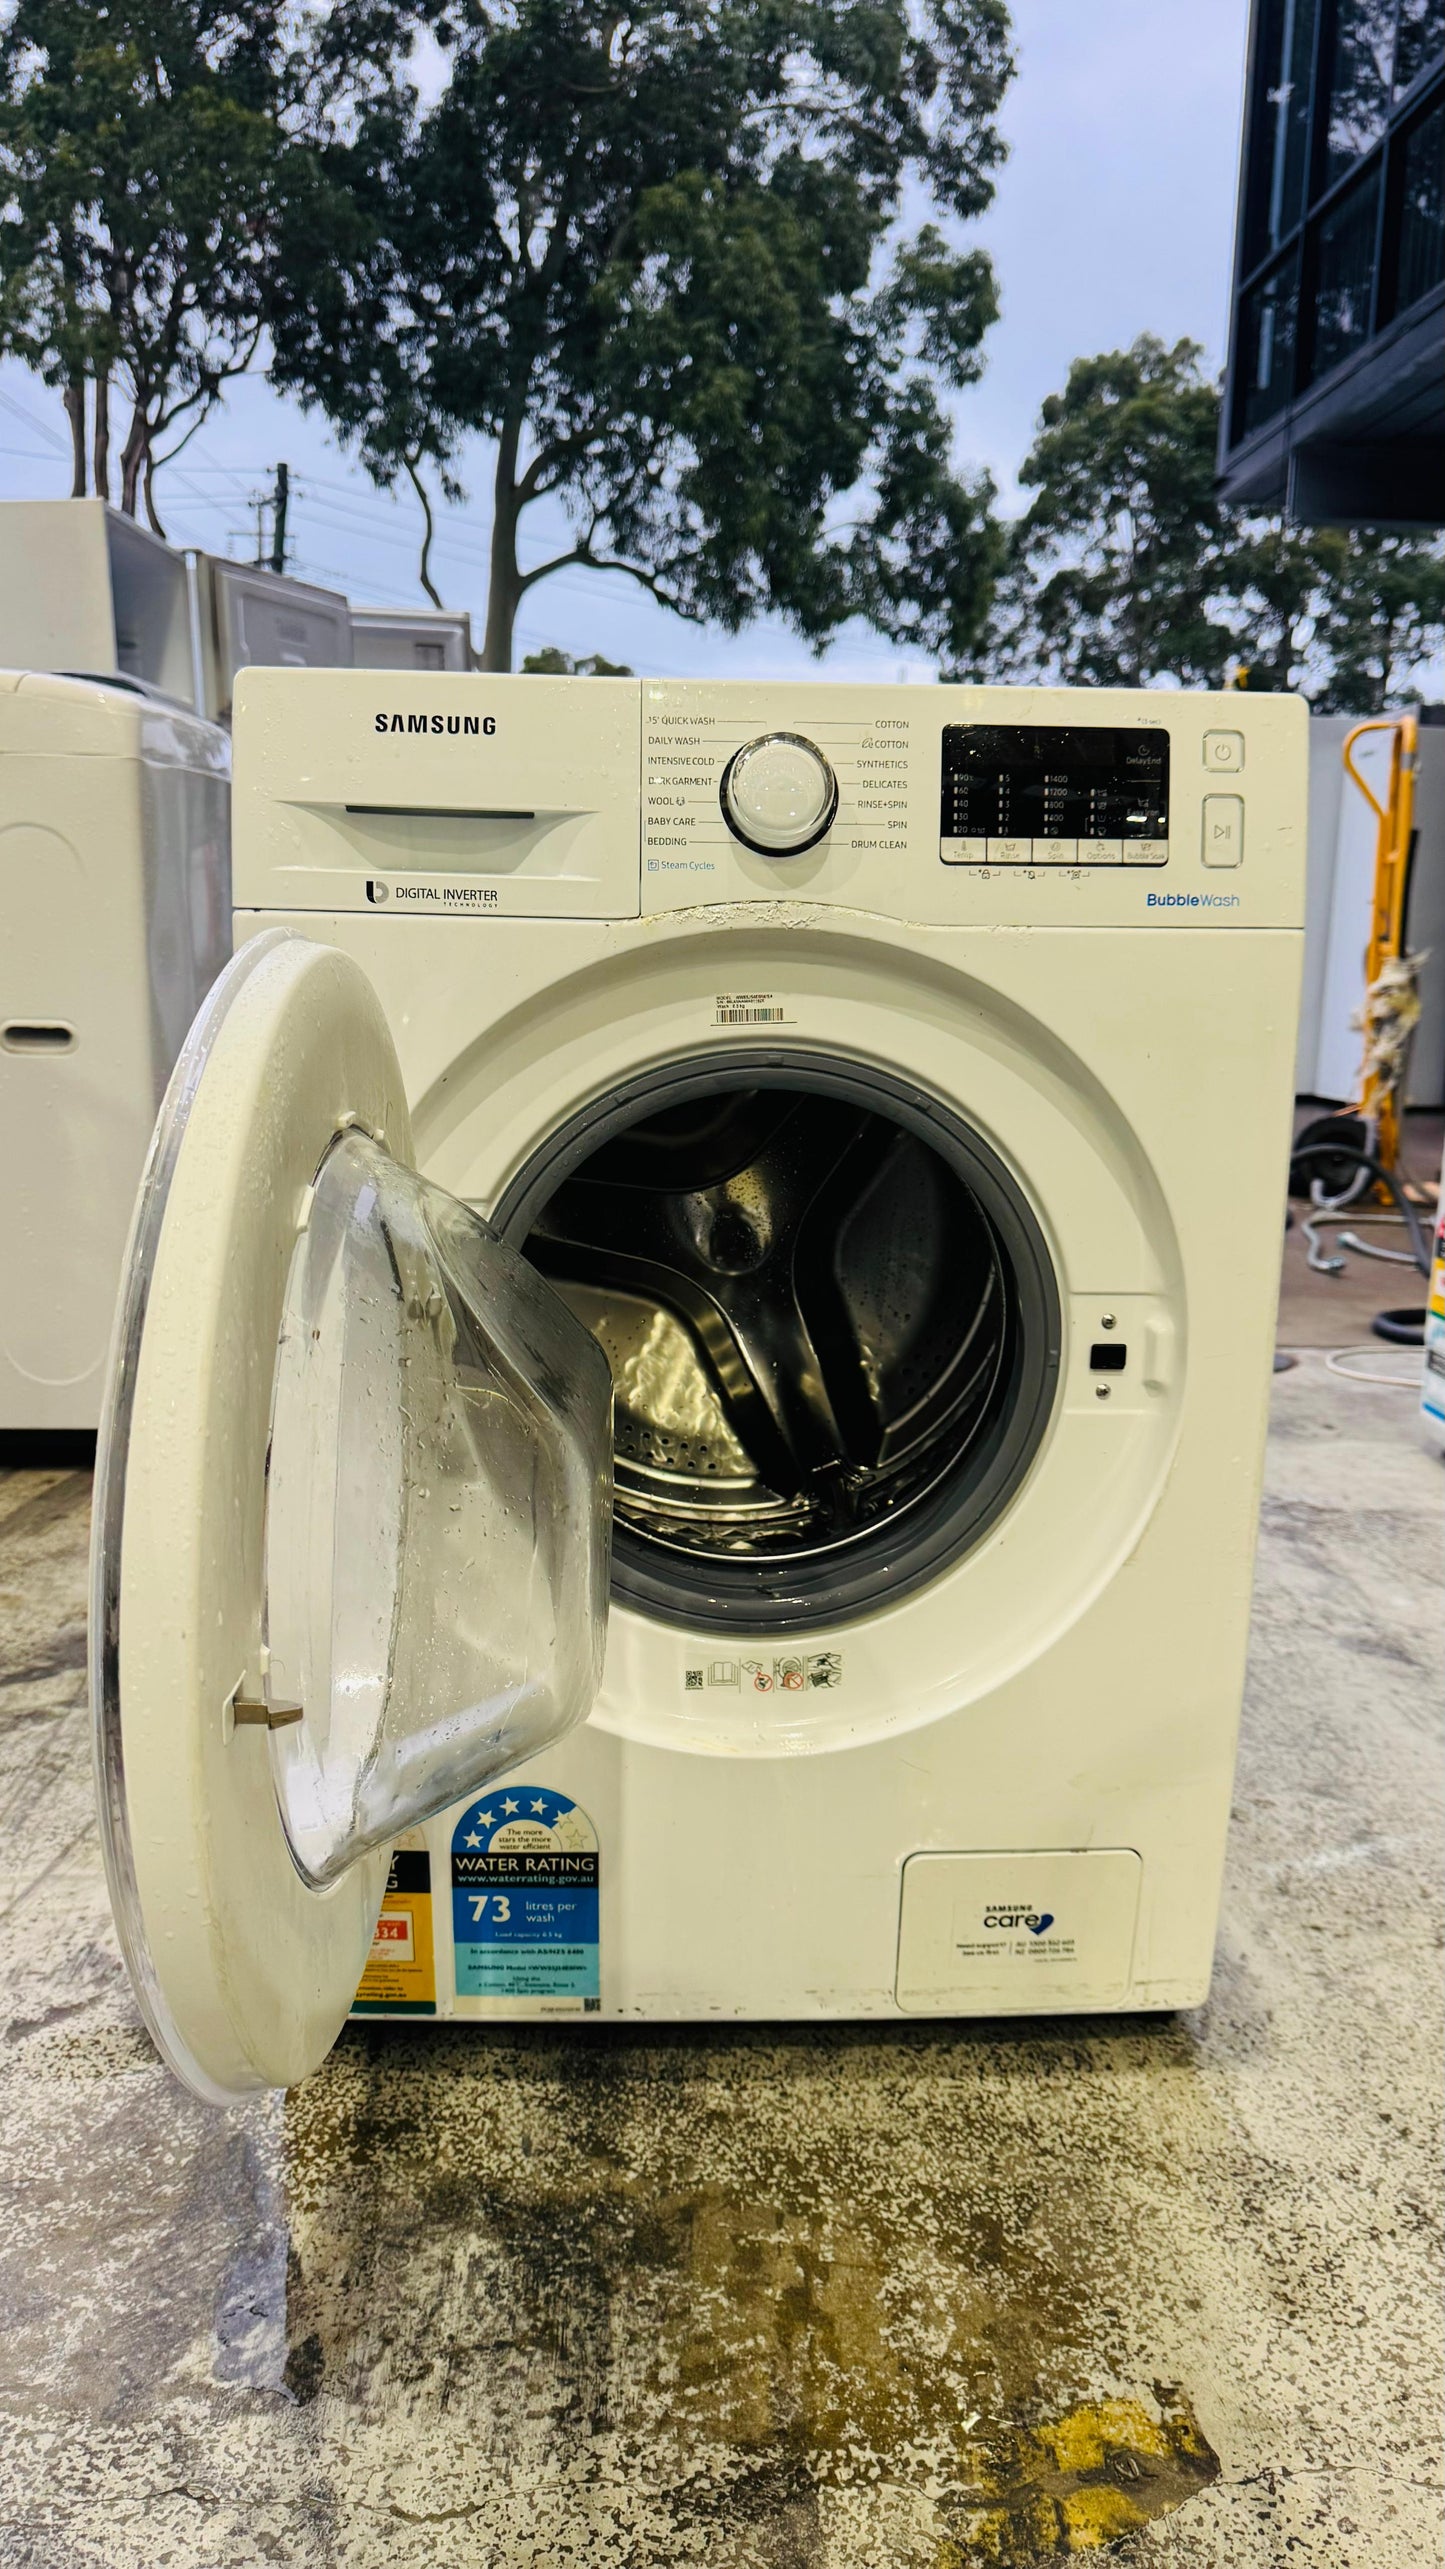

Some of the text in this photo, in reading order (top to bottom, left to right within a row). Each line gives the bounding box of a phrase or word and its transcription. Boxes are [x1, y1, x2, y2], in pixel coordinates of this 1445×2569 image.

[375, 713, 497, 736] SAMSUNG
[662, 716, 689, 725] QUICK
[690, 716, 716, 725] WASH
[875, 720, 910, 729] COTTON
[648, 736, 701, 745] DAILY WASH
[874, 740, 909, 749] COTTON
[648, 757, 715, 766] INTENSIVE COLD
[857, 760, 909, 769] SYNTHETICS
[648, 777, 713, 786] DRK GARMENT
[862, 780, 909, 789] DELICATES
[959, 787, 969, 795] 60
[1050, 788, 1068, 796] 1200
[648, 797, 674, 805] WOOL
[858, 800, 908, 809] RINSE+SPIN
[648, 817, 696, 826] BABY CARE
[1049, 814, 1064, 822] 400
[887, 821, 908, 830] SPIN
[647, 837, 687, 846] BEDDING
[851, 840, 907, 849] DRUM CLEAN
[1087, 852, 1116, 861] Options
[661, 861, 715, 872] Steam Cycles
[396, 887, 498, 901] DIGITAL INVERTER
[456, 1858, 594, 1872] WATER RATING
[457, 1873, 594, 1885] www.waterrating.gov.au
[468, 1895, 511, 1923] 73
[526, 1901, 577, 1913] litres per
[526, 1913, 555, 1923] wash
[984, 1914, 1039, 1929] care
